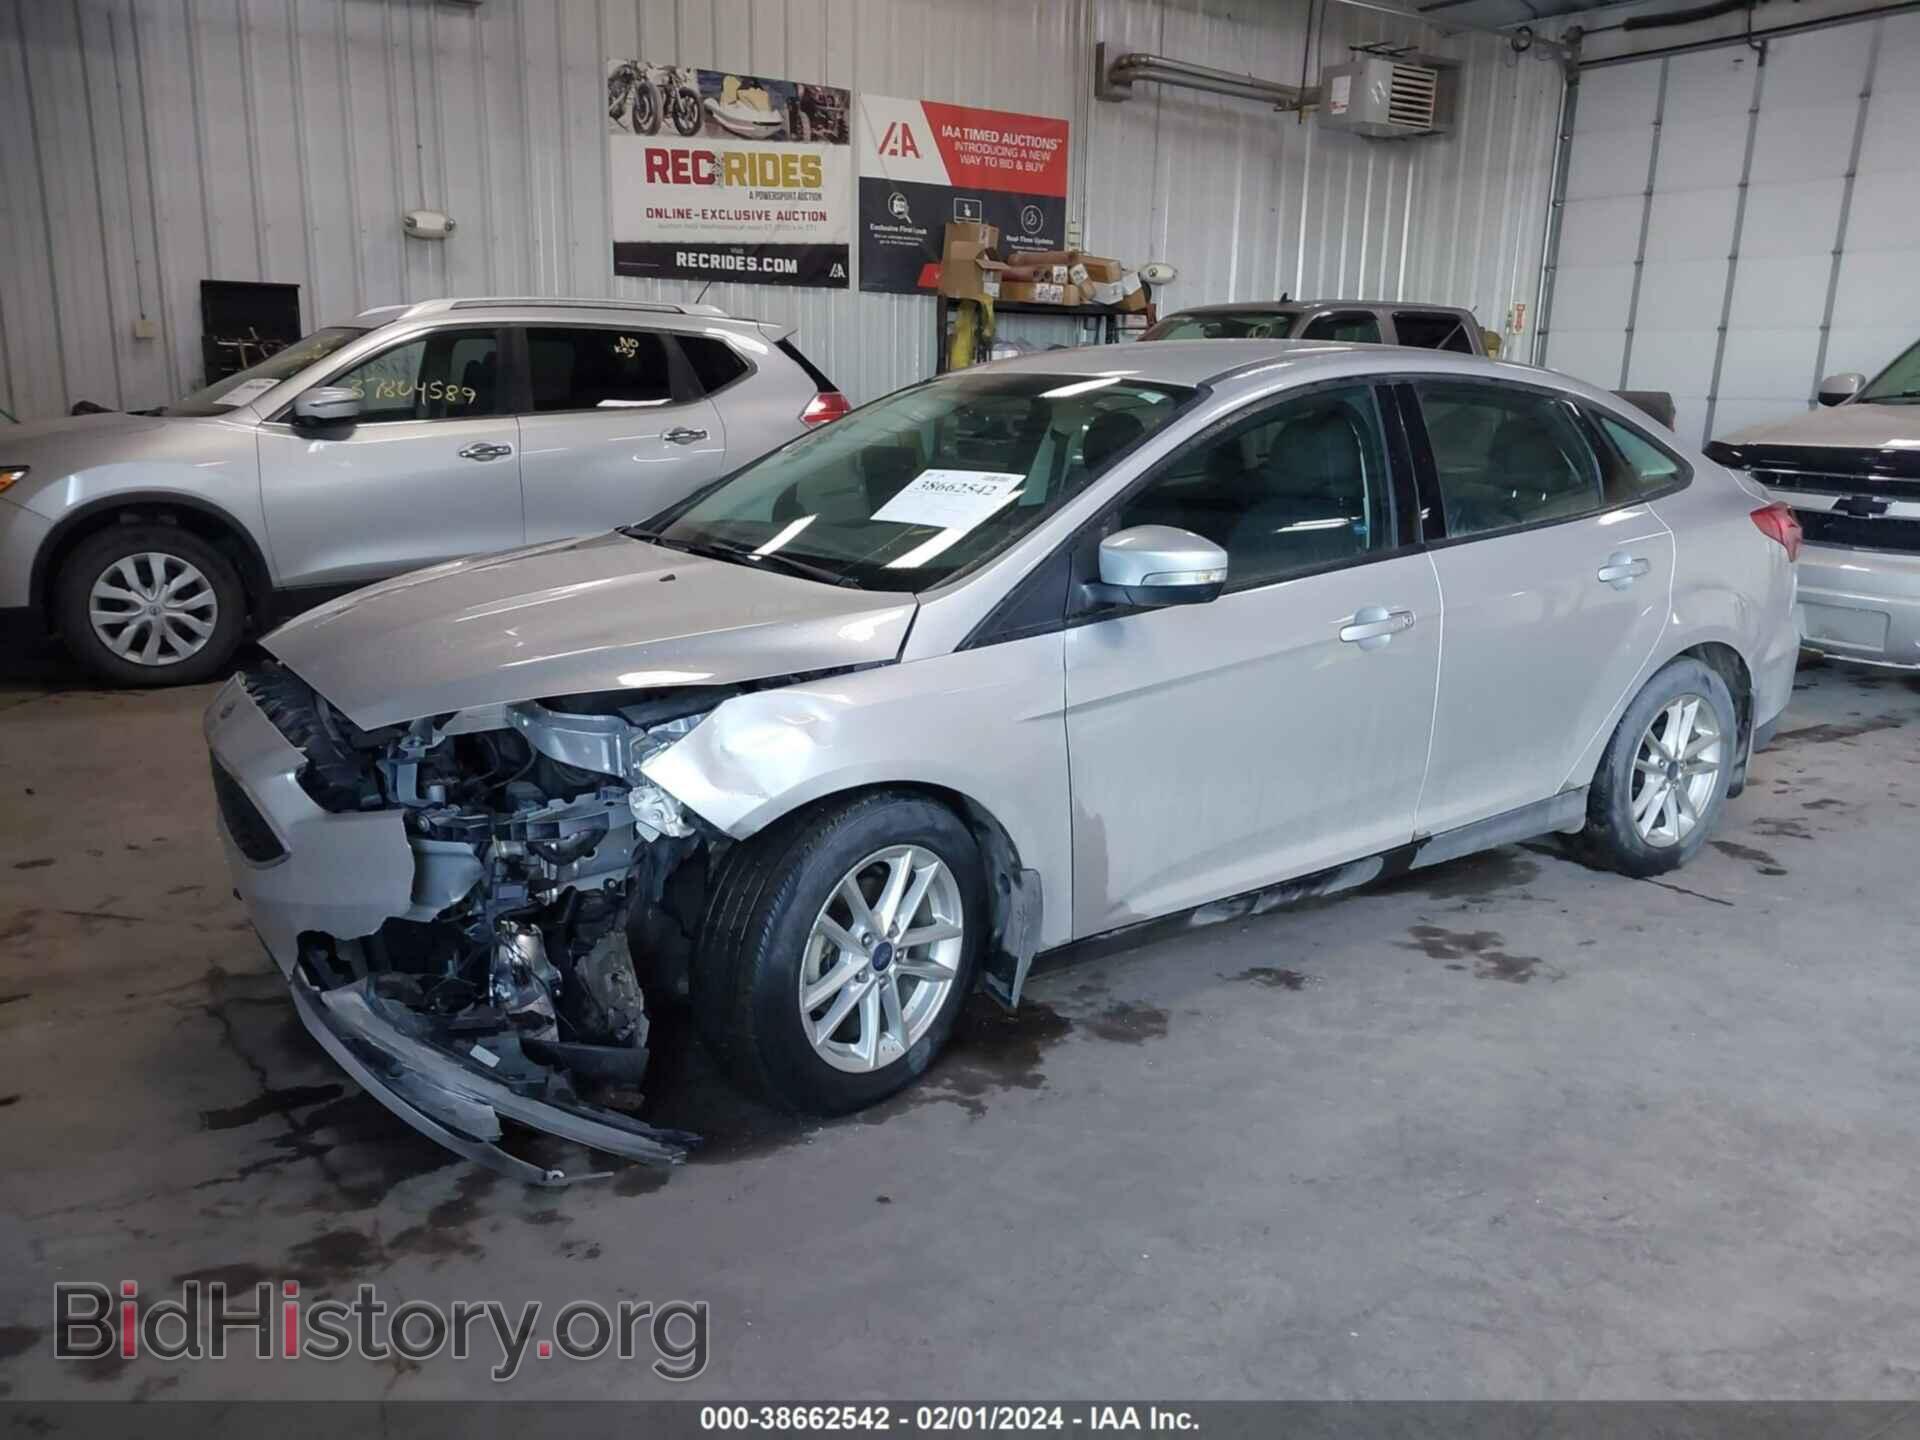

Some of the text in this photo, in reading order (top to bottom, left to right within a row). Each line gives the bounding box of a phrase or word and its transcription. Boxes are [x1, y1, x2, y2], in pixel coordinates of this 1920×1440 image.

[942, 125, 961, 139] IAA
[962, 127, 1000, 143] TIMED
[954, 141, 1051, 161] INTRODUCING A NEW
[960, 154, 1046, 173] WAY TO BID & BUY
[798, 191, 822, 201] AUCTION
[646, 208, 828, 222] ONLINE-EXCLUSIVE AUCTION
[676, 251, 798, 274] RECRIDES.COM
[921, 479, 998, 496] 38662542
